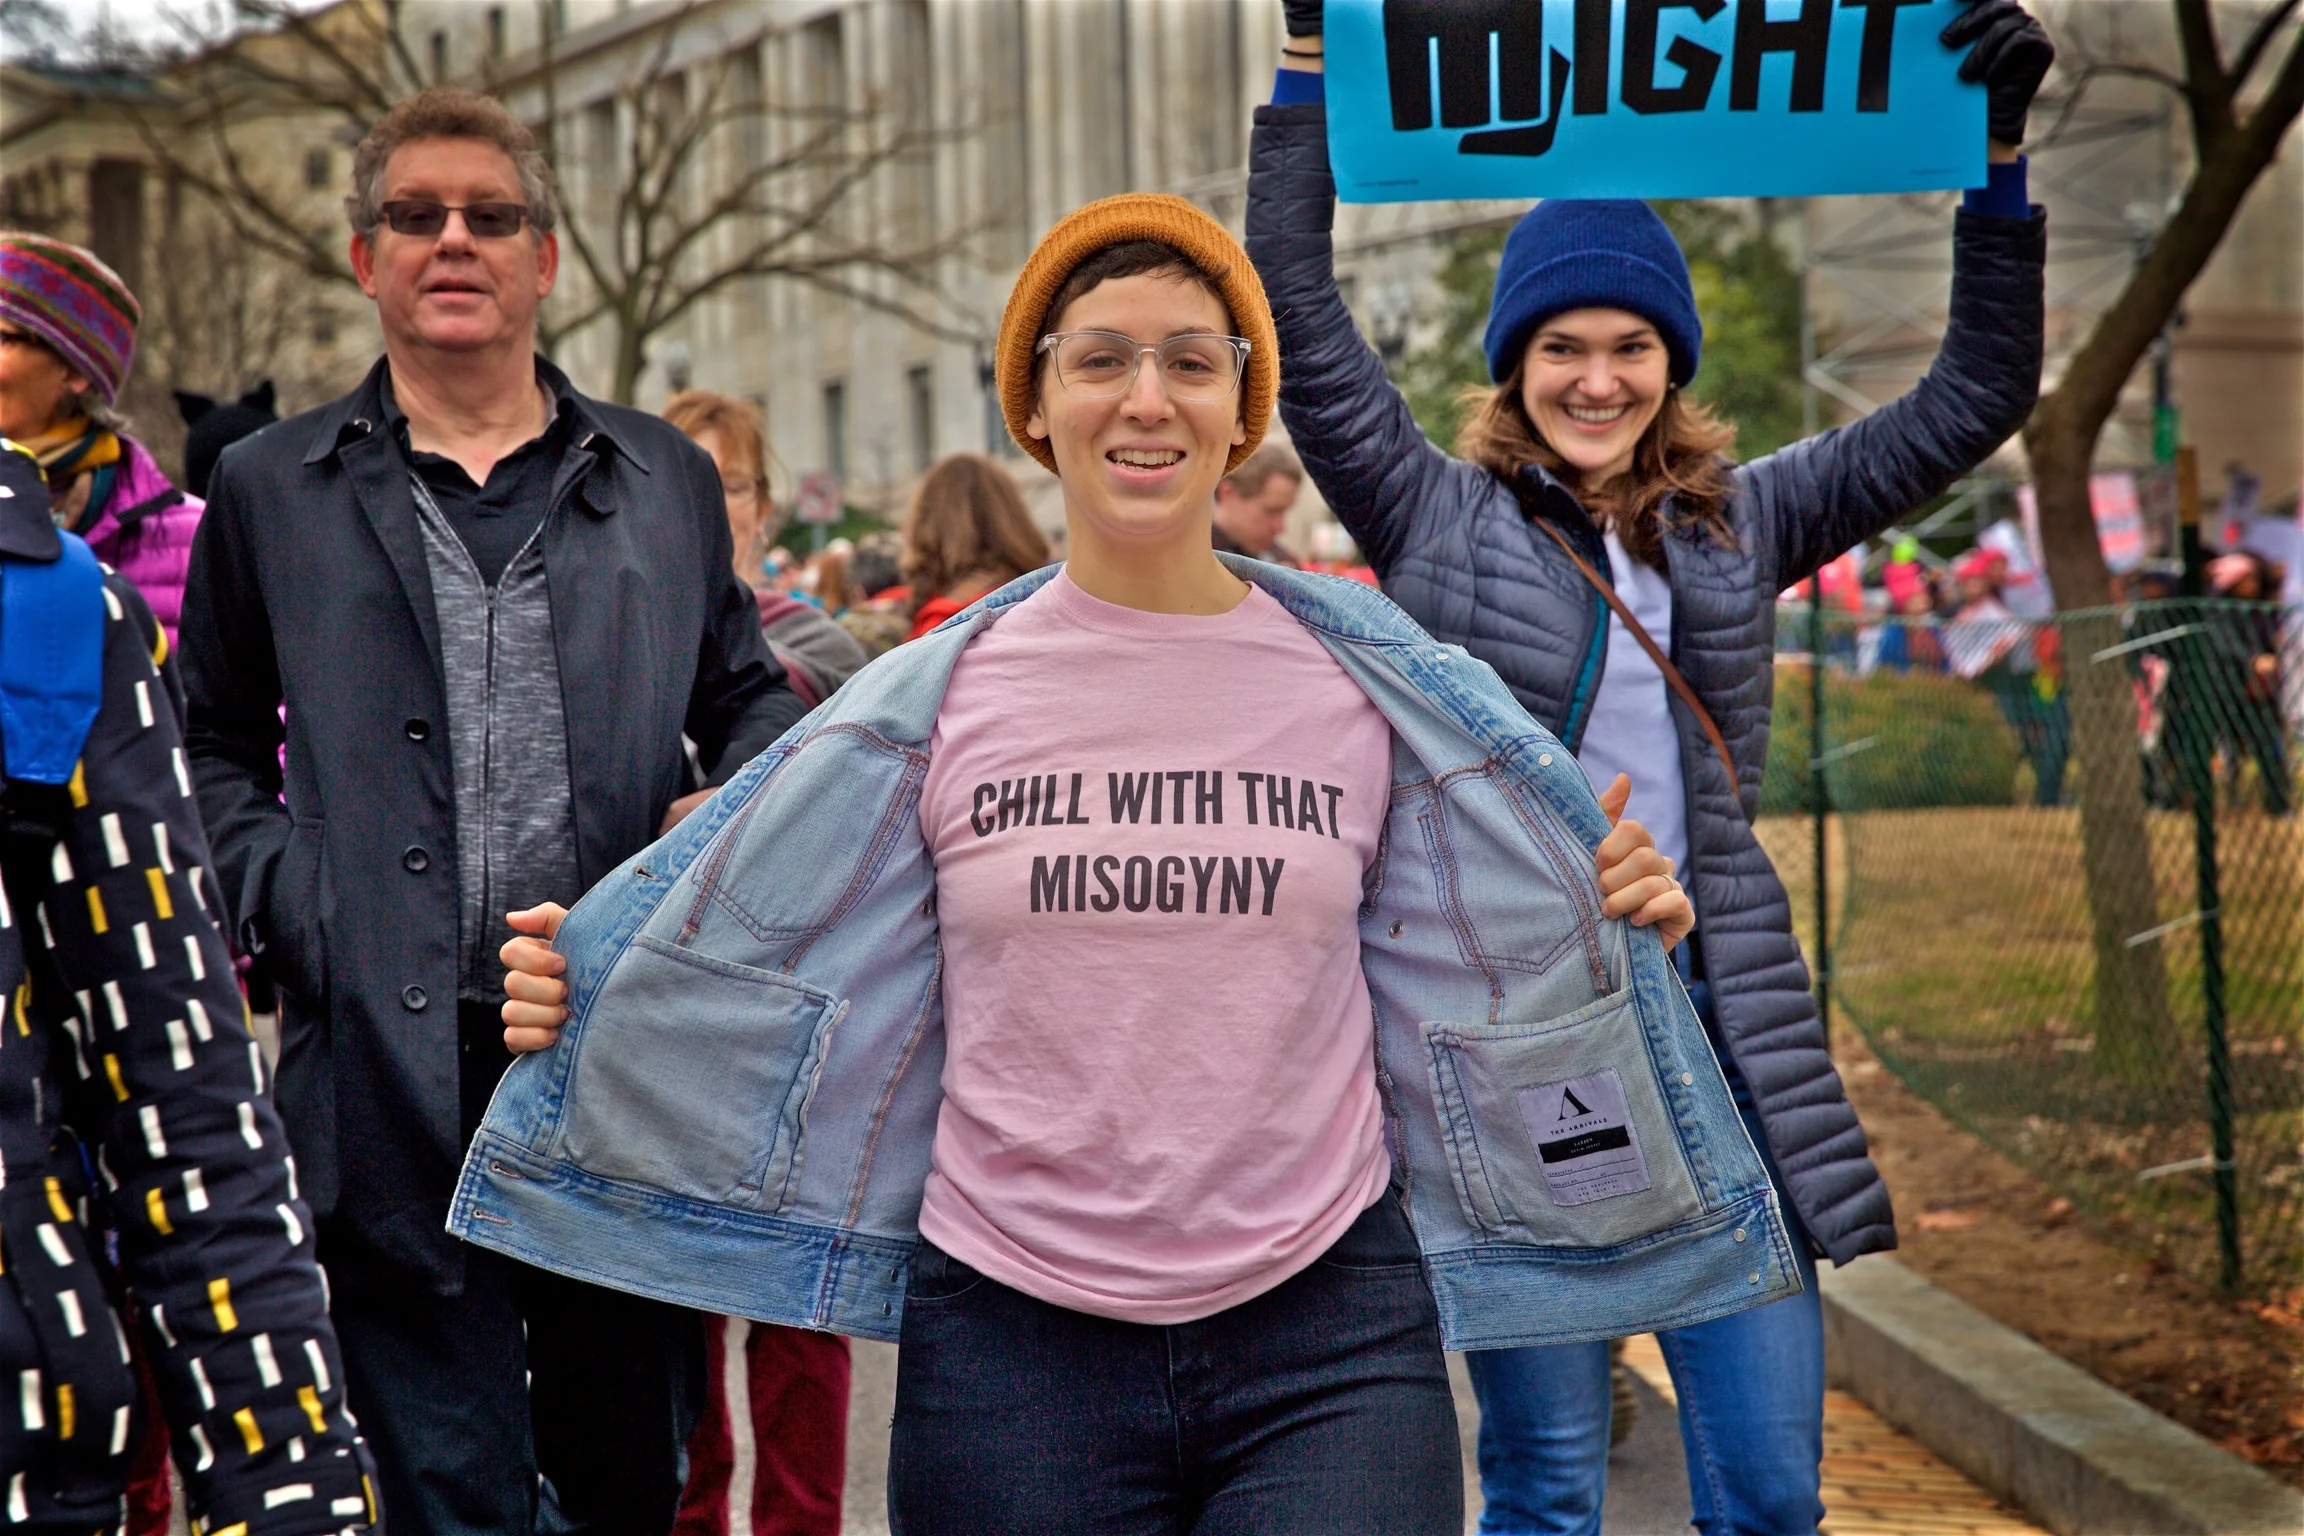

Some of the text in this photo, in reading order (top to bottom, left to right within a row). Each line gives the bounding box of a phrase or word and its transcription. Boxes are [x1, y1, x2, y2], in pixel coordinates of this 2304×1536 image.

[970, 771, 1344, 839] CHILL WITH THAT
[1030, 855, 1285, 916] MISOGYNY
